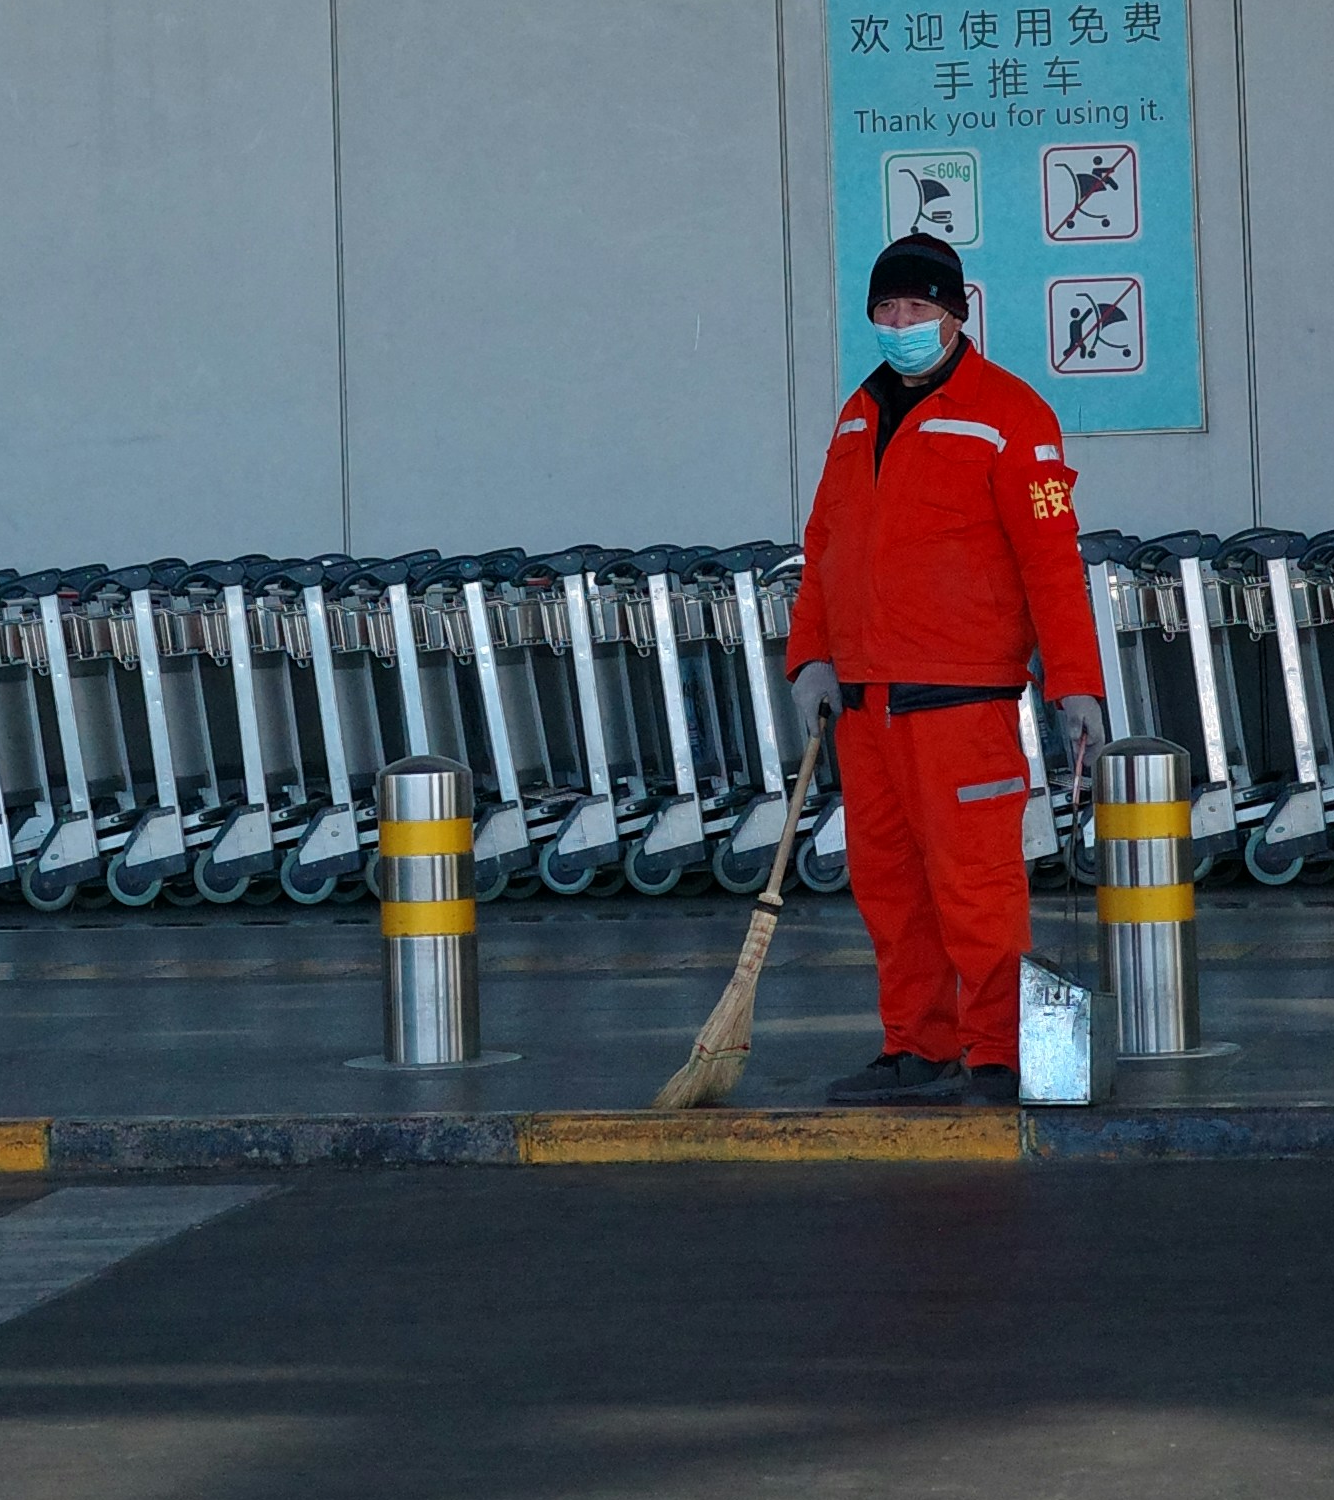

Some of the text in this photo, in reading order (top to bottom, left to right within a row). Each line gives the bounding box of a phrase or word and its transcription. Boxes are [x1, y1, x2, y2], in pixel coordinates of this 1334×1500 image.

[849, 1, 1162, 55] 欢迎使用免费
[932, 55, 1083, 101] 手推车
[853, 97, 1165, 137] Thank you for using it.
